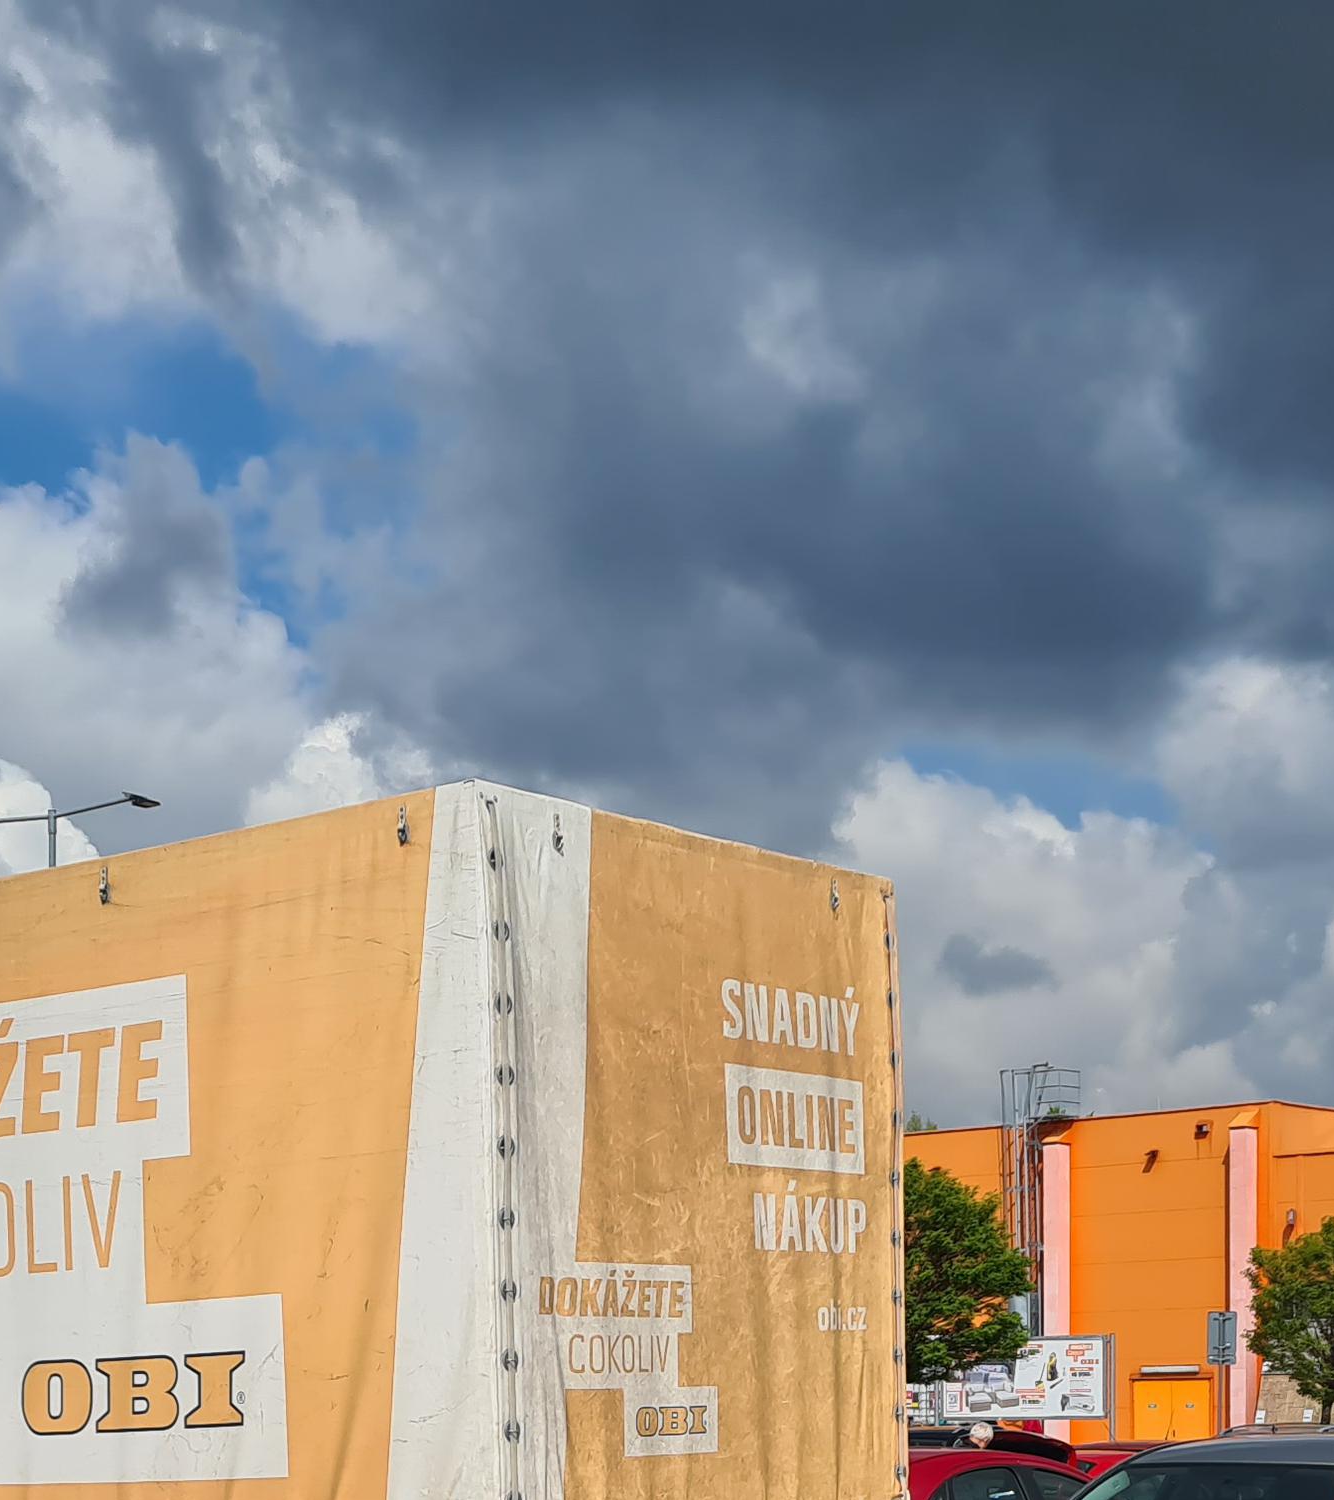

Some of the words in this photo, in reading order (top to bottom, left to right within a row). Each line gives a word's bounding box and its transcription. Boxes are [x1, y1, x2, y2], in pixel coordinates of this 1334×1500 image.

[721, 978, 860, 1056] SNADNÝ
[737, 1085, 856, 1154] ONLINE
[753, 1179, 867, 1254] NÁKUP
[538, 1269, 685, 1318] DOKÁŽETE
[818, 1300, 867, 1332] obi.cz
[568, 1333, 670, 1374] COKOLIV
[21, 1350, 246, 1435] OBI
[636, 1405, 708, 1437] OBI
